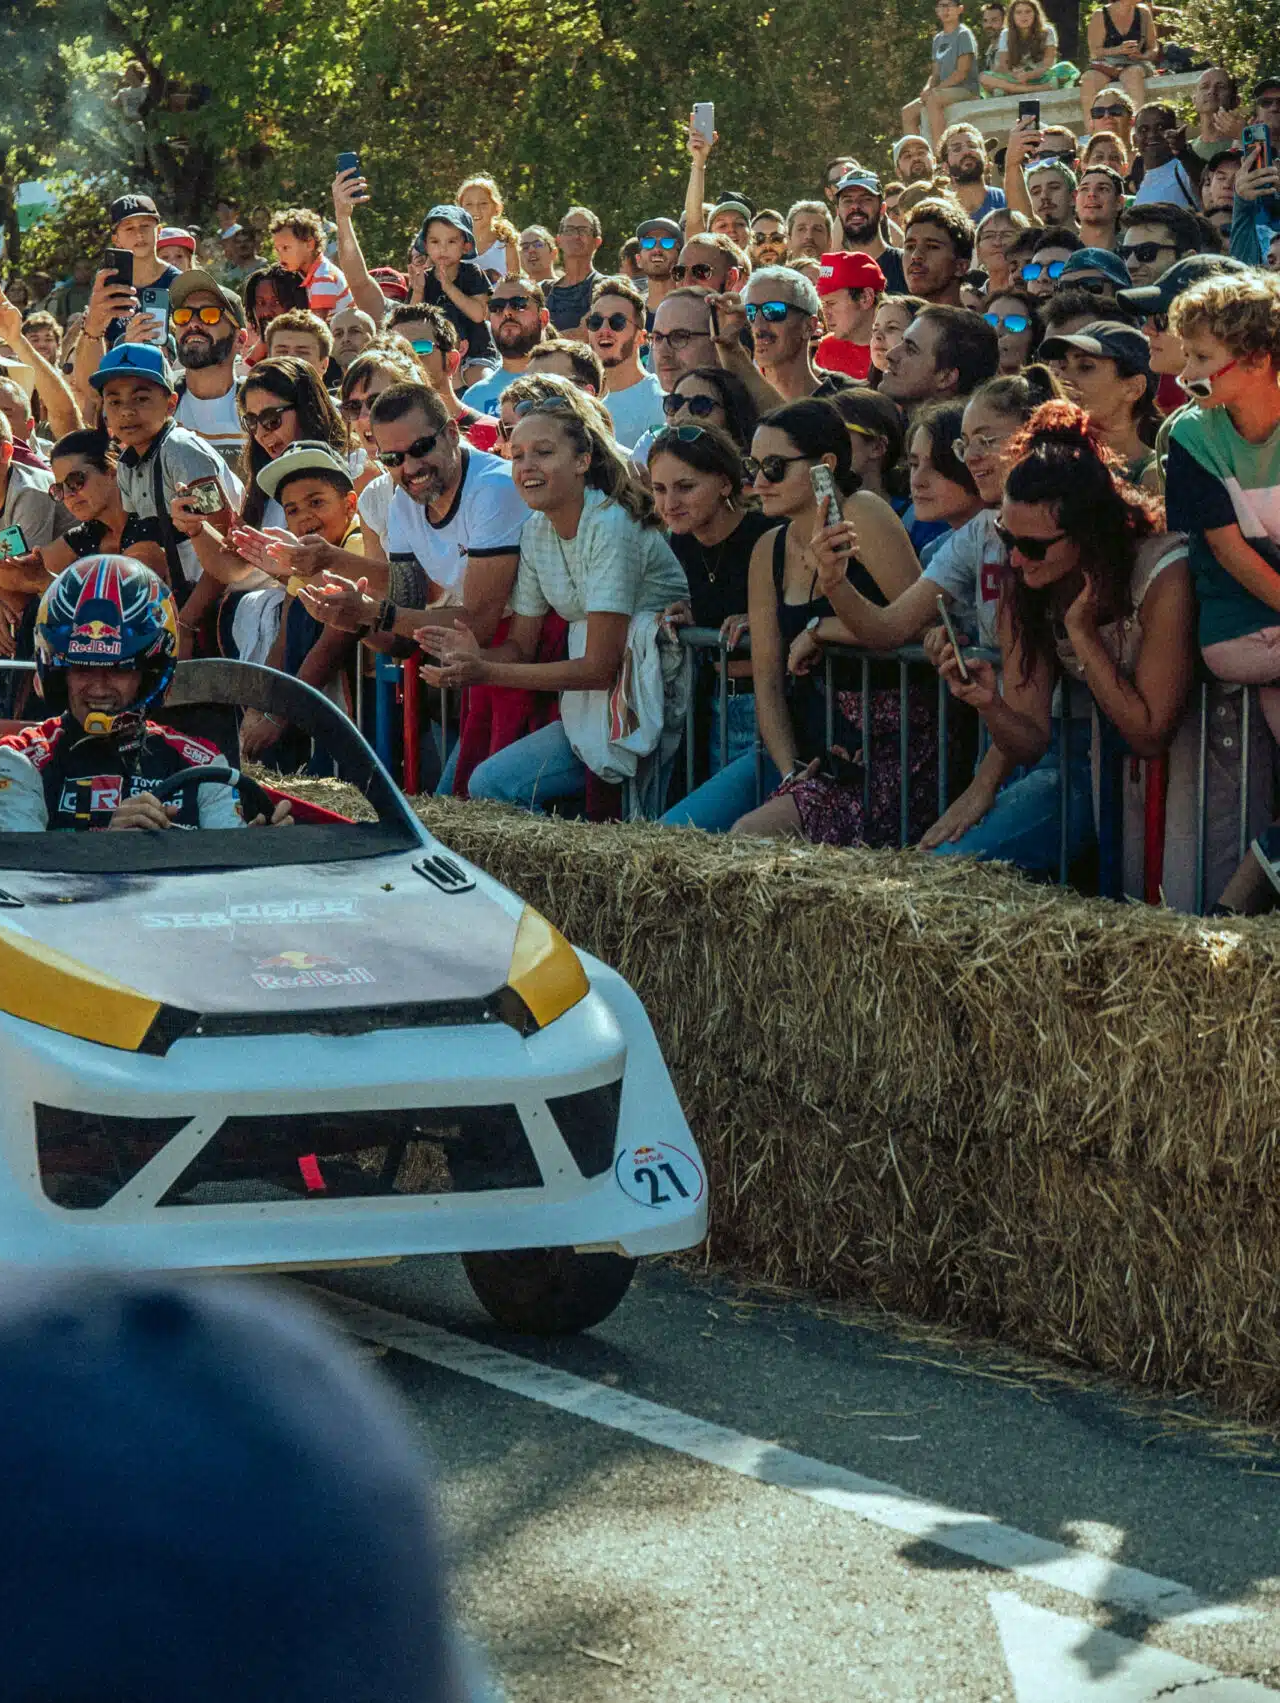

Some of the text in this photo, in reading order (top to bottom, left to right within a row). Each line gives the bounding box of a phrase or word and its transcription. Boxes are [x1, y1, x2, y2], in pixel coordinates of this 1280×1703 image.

[69, 639, 121, 655] Red Bull
[142, 899, 360, 929] SEB OGIER
[251, 967, 377, 990] Red Bull
[634, 1153, 663, 1165] Red Bull
[634, 1162, 690, 1205] 21
